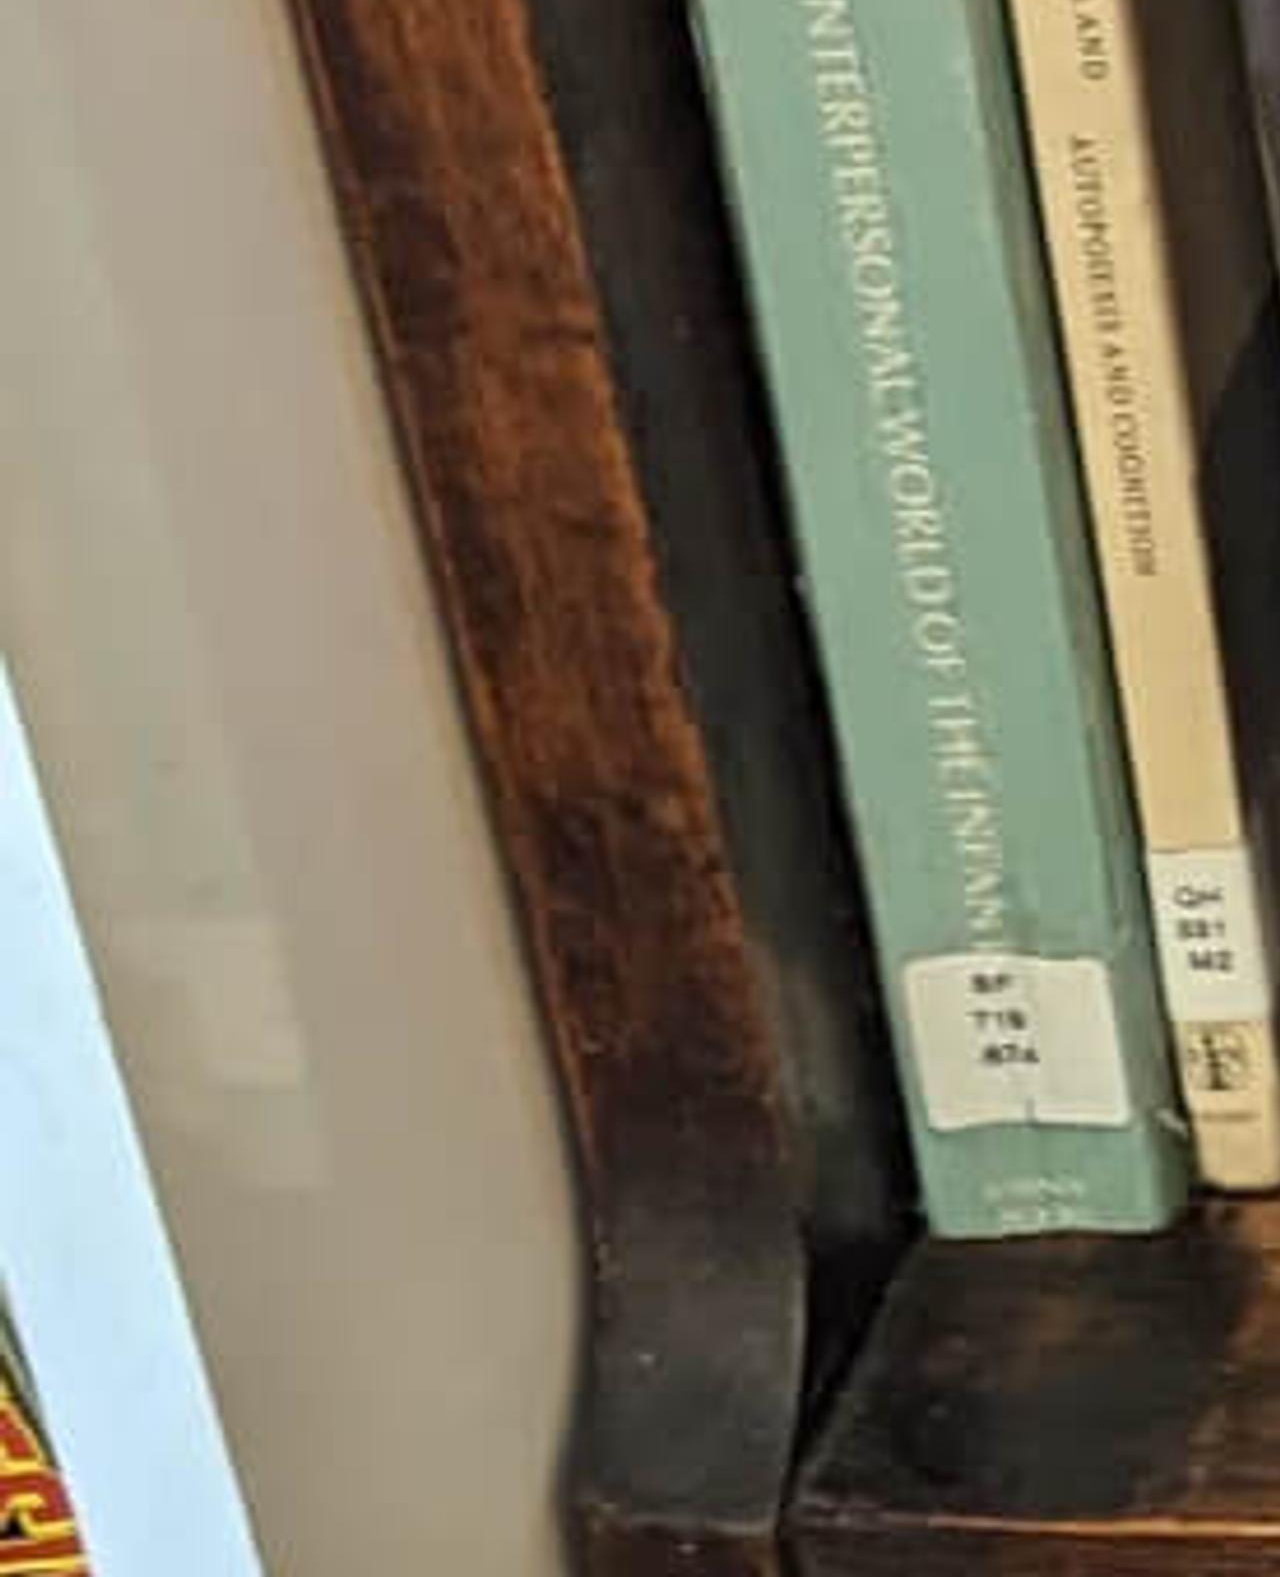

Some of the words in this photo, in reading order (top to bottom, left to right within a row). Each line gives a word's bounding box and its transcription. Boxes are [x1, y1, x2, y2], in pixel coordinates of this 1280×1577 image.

[1074, 13, 1110, 83] AND
[1098, 342, 1133, 410] AND
[868, 404, 964, 607] WORLD
[903, 607, 974, 685] OF
[918, 693, 988, 783] THE
